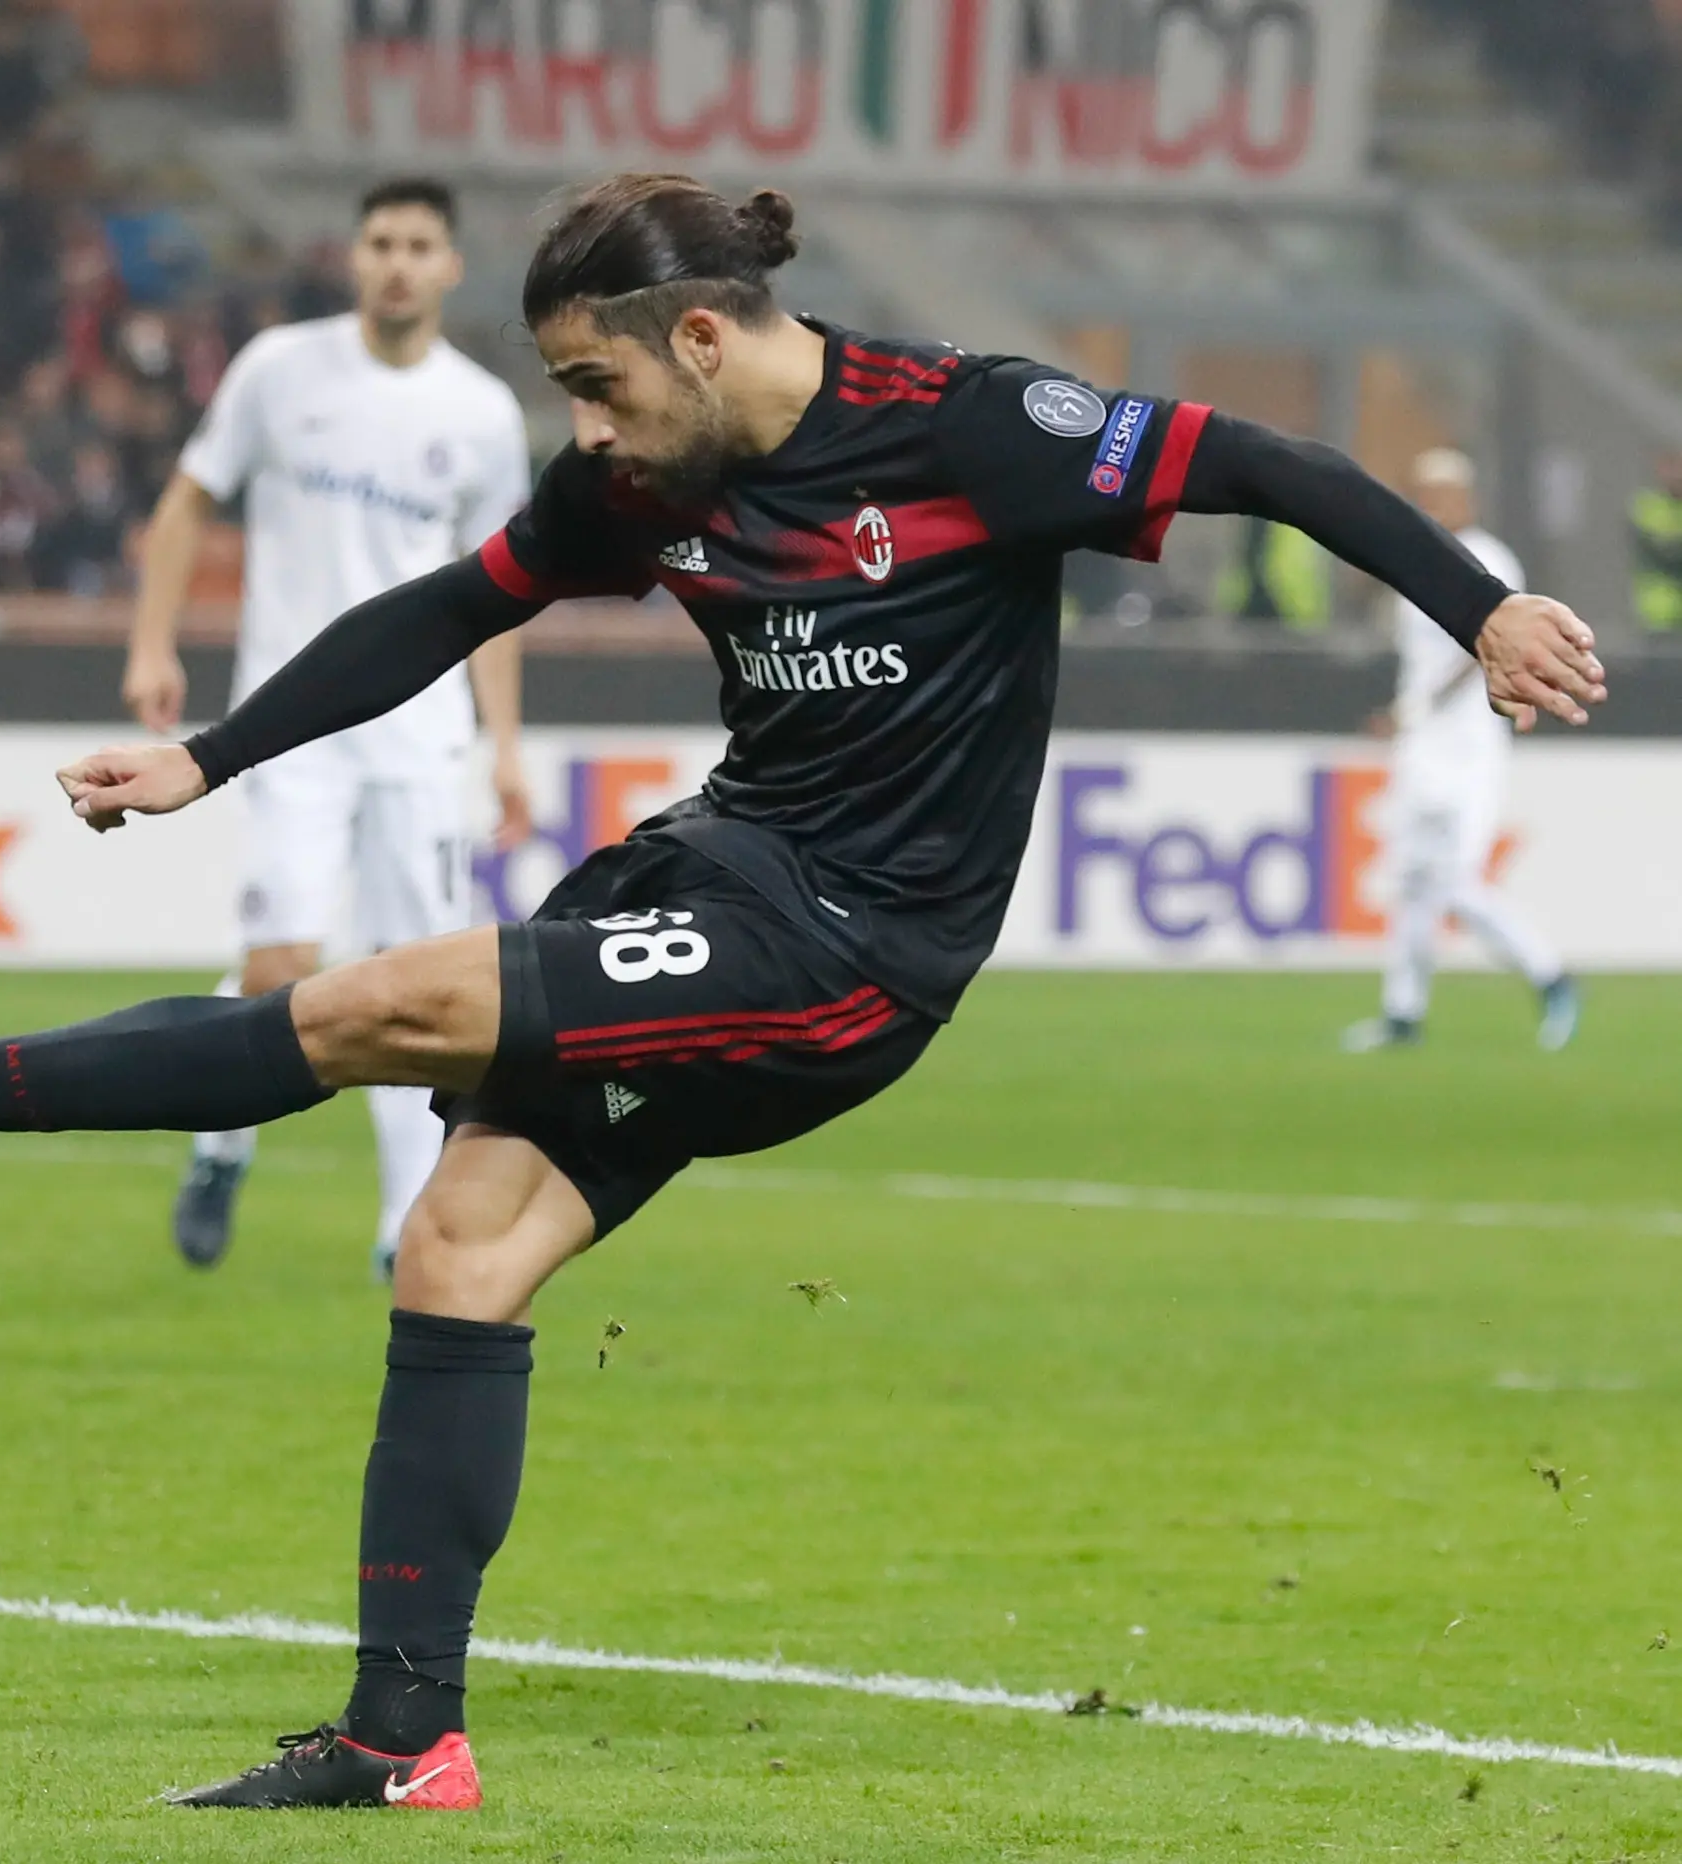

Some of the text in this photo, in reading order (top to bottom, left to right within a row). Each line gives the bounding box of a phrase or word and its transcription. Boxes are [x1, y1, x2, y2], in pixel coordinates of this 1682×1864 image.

[343, 0, 1315, 416] MARCO NICO 7
[1106, 399, 1143, 465] RESPECT
[659, 553, 710, 573] adidas
[765, 604, 818, 647] Fly
[727, 632, 909, 692] Emirates
[1057, 765, 1521, 938] FedE
[604, 1081, 622, 1124] adidas
